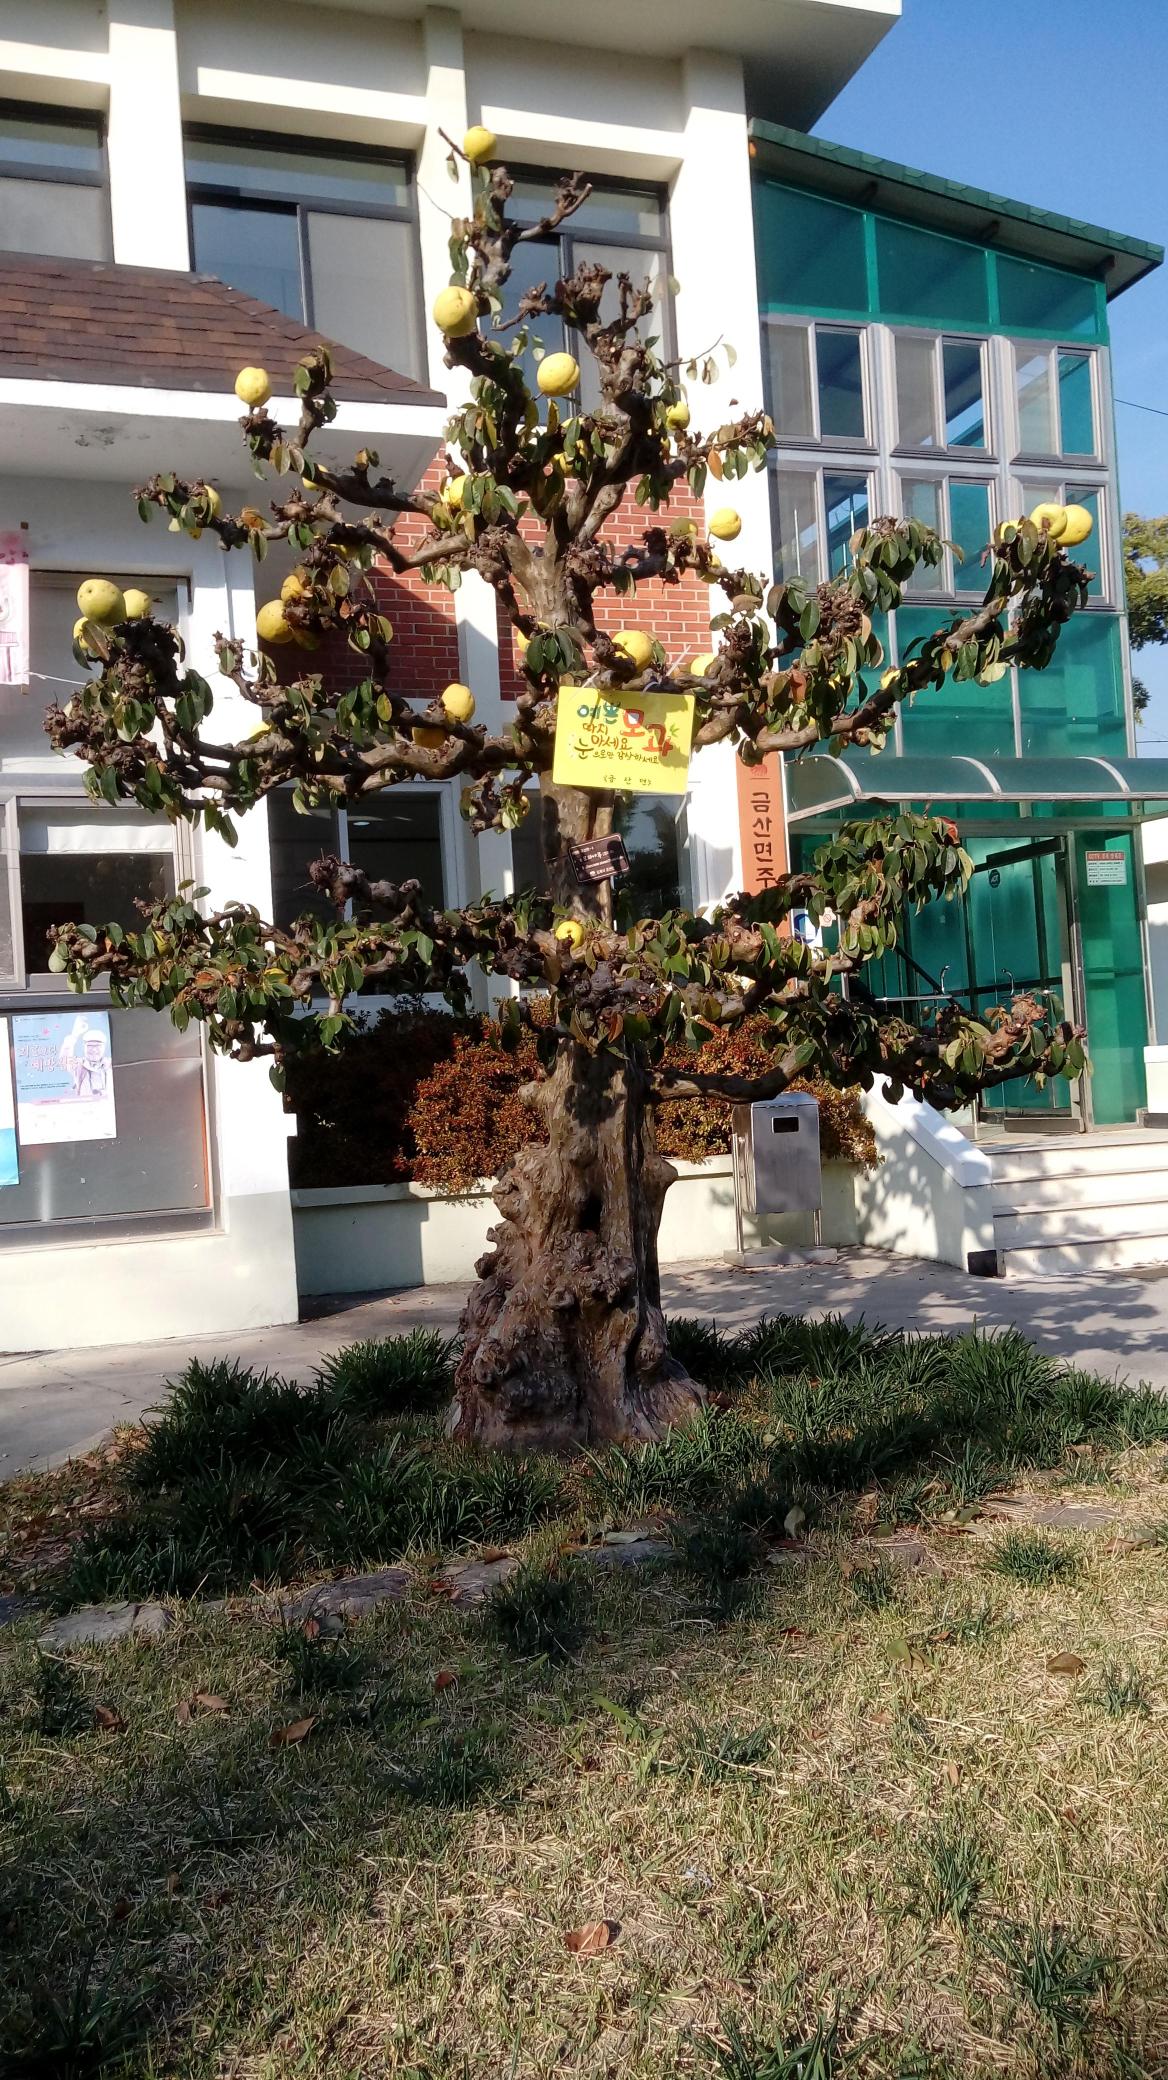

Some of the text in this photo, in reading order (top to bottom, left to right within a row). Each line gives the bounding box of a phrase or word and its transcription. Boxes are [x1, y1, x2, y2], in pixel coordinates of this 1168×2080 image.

[576, 701, 674, 757] 예쁜 모과
[582, 722, 608, 736] 따지
[574, 738, 660, 764] 눈으로만 감상하세요
[591, 735, 632, 751] 마세요
